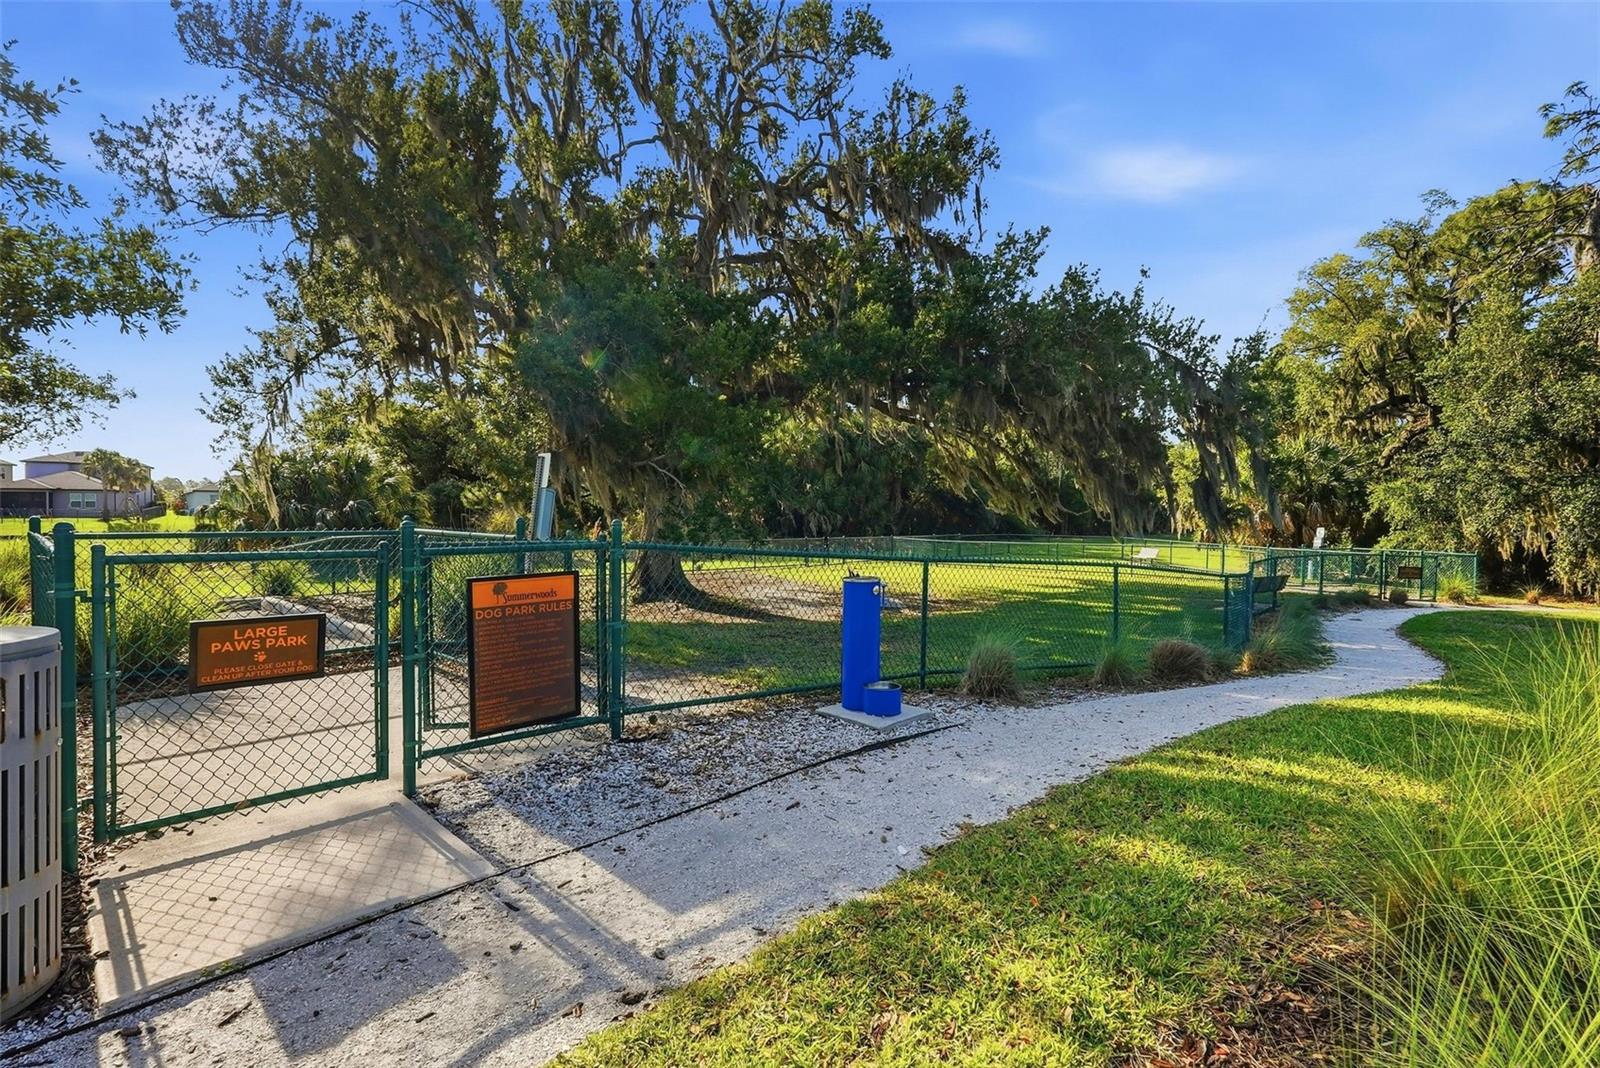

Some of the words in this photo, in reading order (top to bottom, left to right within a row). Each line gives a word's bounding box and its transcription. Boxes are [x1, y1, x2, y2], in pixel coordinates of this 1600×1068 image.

[503, 588, 558, 603] Summerwoods
[475, 609, 502, 620] DOG
[505, 605, 536, 616] PARK
[539, 601, 573, 612] RULES
[233, 625, 288, 640] LARGE
[211, 639, 261, 653] PAWS
[266, 635, 308, 648] PARK
[201, 674, 231, 683] CLEAN
[232, 672, 243, 680] UP
[245, 670, 271, 678] AFTER
[274, 667, 295, 675] YOUR
[296, 664, 314, 672] DOG
[214, 666, 245, 675] PLEASE
[247, 663, 274, 671] CLOSE
